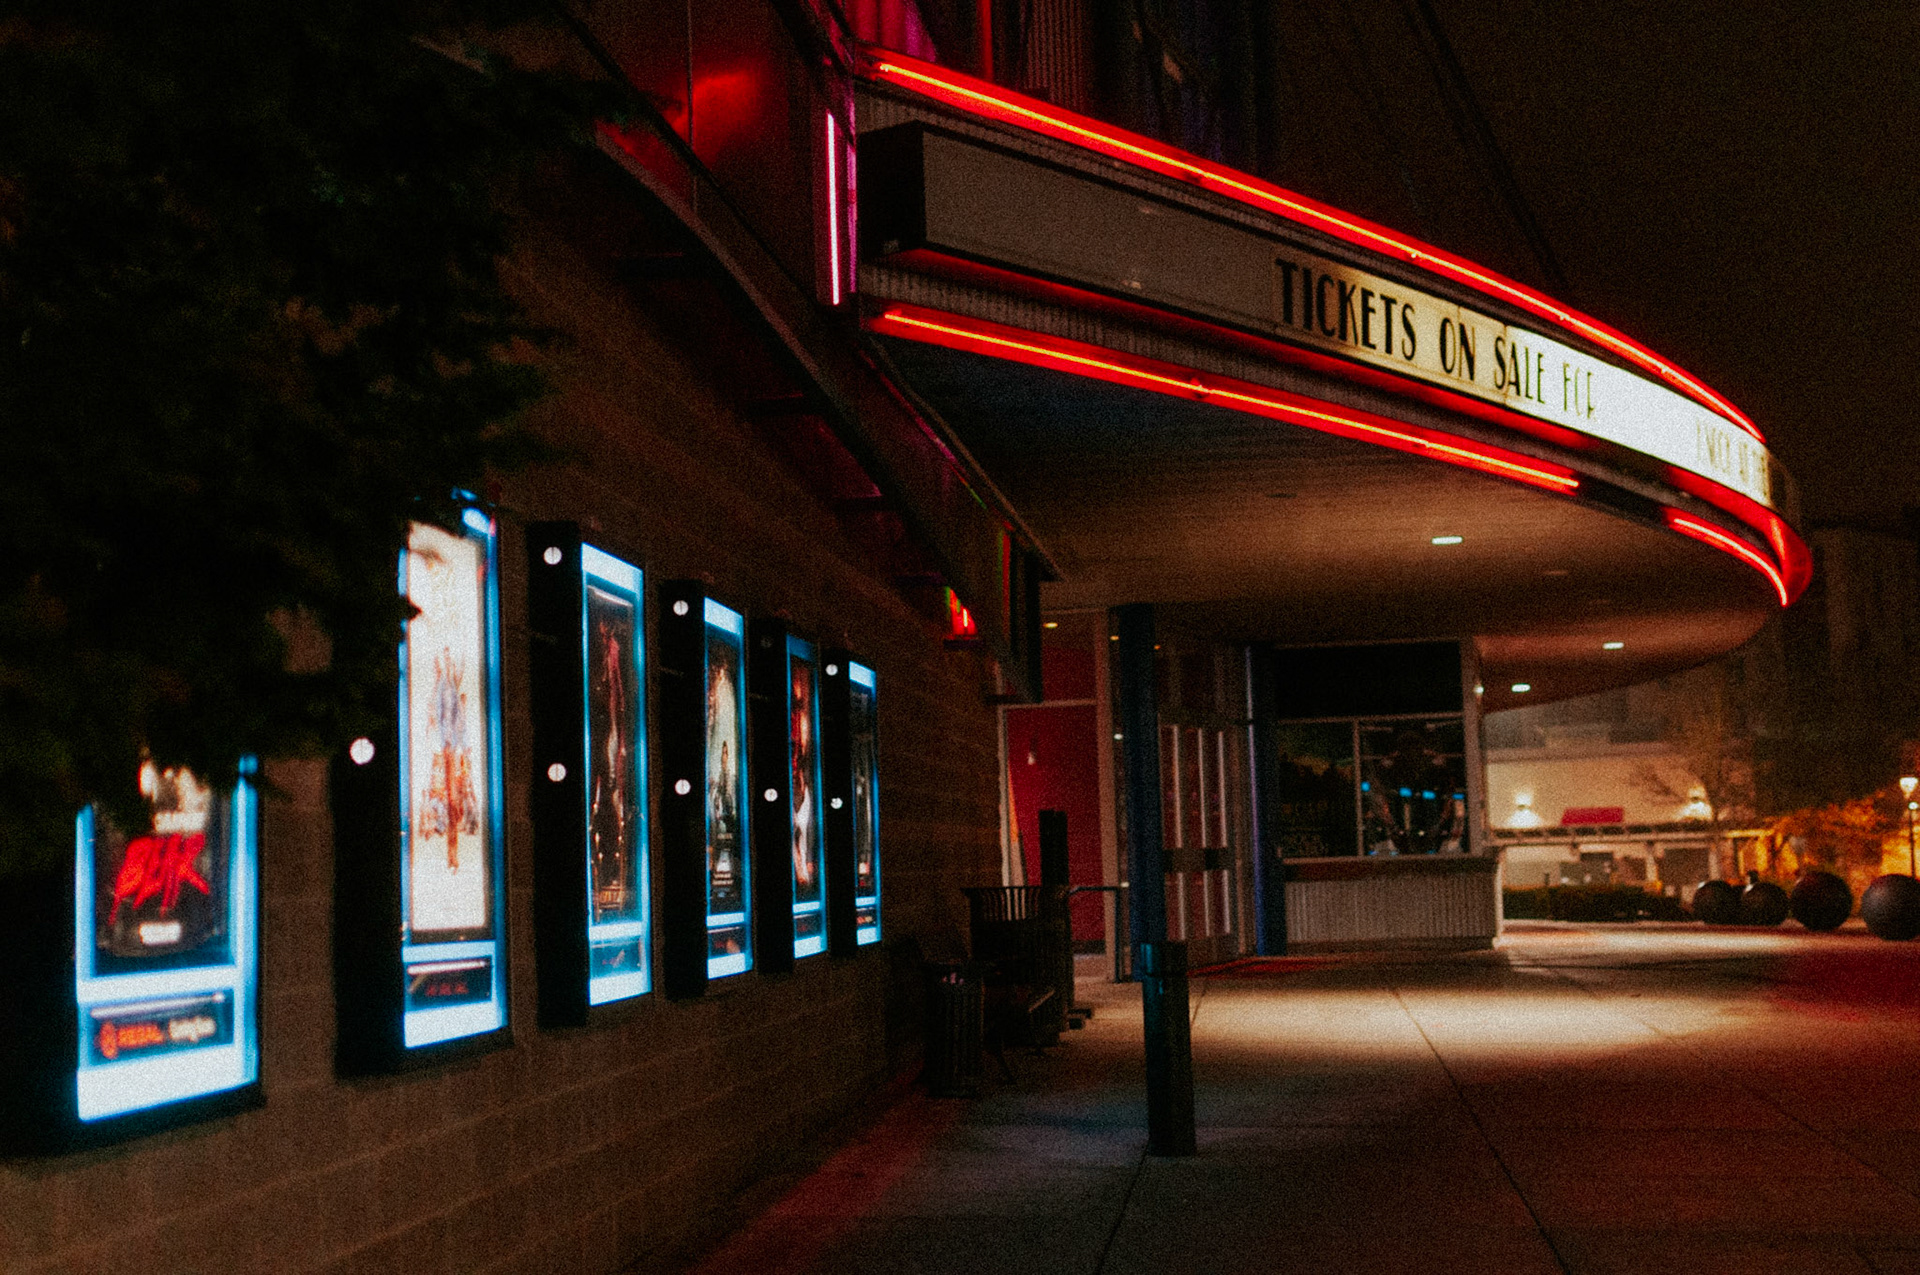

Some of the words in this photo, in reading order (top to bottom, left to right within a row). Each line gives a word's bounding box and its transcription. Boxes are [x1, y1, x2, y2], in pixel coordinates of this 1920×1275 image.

[1275, 258, 1416, 361] TICKETS
[1440, 317, 1476, 381] ON
[1494, 335, 1546, 405] SALE
